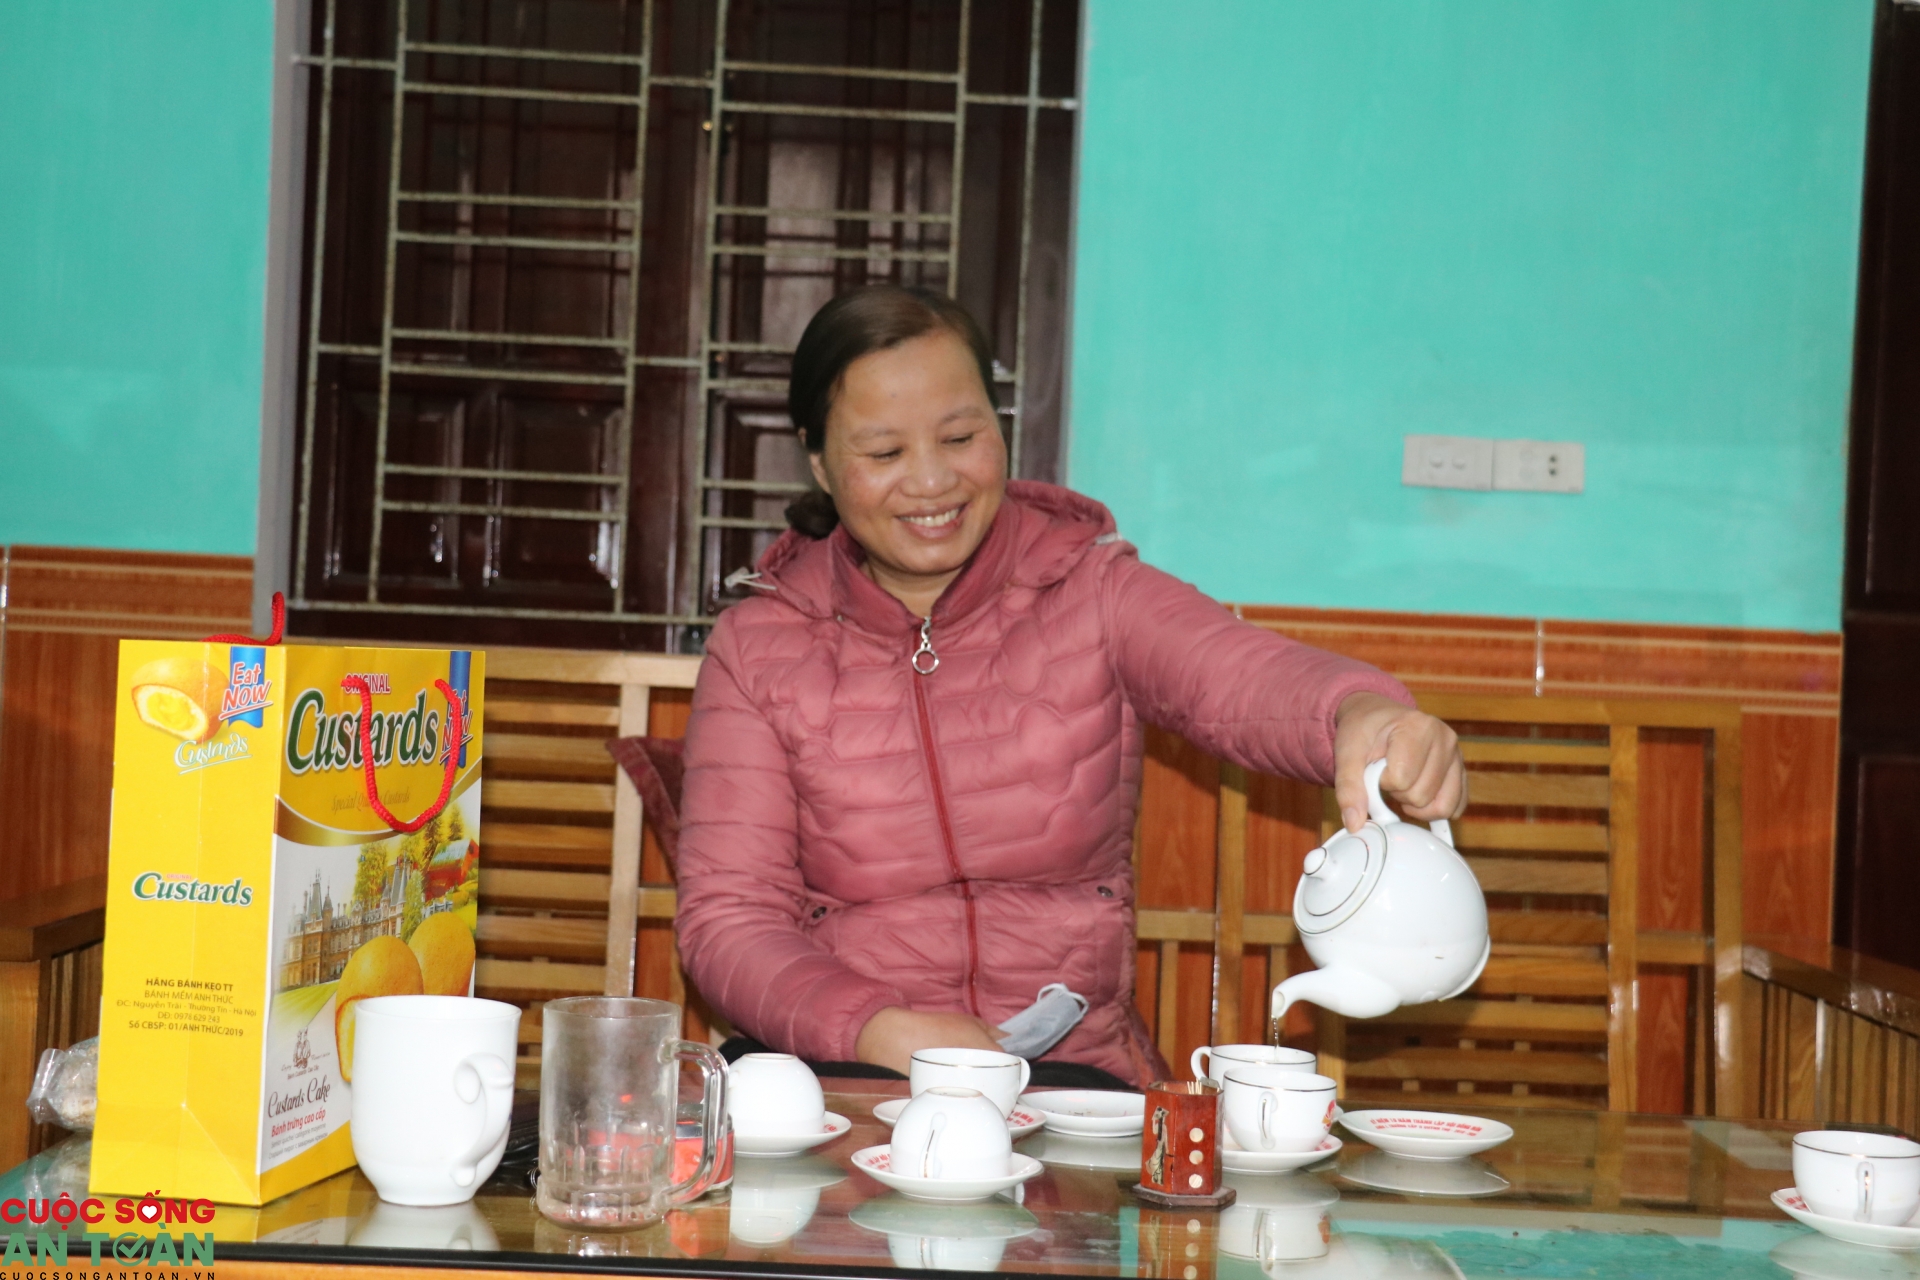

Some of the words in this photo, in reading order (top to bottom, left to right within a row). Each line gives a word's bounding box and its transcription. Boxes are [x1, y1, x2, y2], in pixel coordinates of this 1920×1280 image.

[233, 662, 262, 686] Eat
[345, 673, 391, 693] GINAL
[221, 680, 273, 713] NOW
[287, 688, 440, 774] Custards
[441, 709, 473, 753] NW
[174, 732, 249, 769] Custards
[133, 871, 253, 906] Custards
[144, 989, 170, 999] BÁNH
[194, 993, 212, 1003] ANH
[177, 979, 203, 990] BÁNH
[204, 982, 222, 993] KẸO
[223, 983, 234, 993] TT
[141, 1021, 167, 1030] CBSP:
[168, 1022, 200, 1032] 01/ANH
[268, 1088, 306, 1118] Custards
[307, 1074, 331, 1103] Cake
[271, 1121, 287, 1137] Bánh
[304, 1112, 315, 1124] cao
